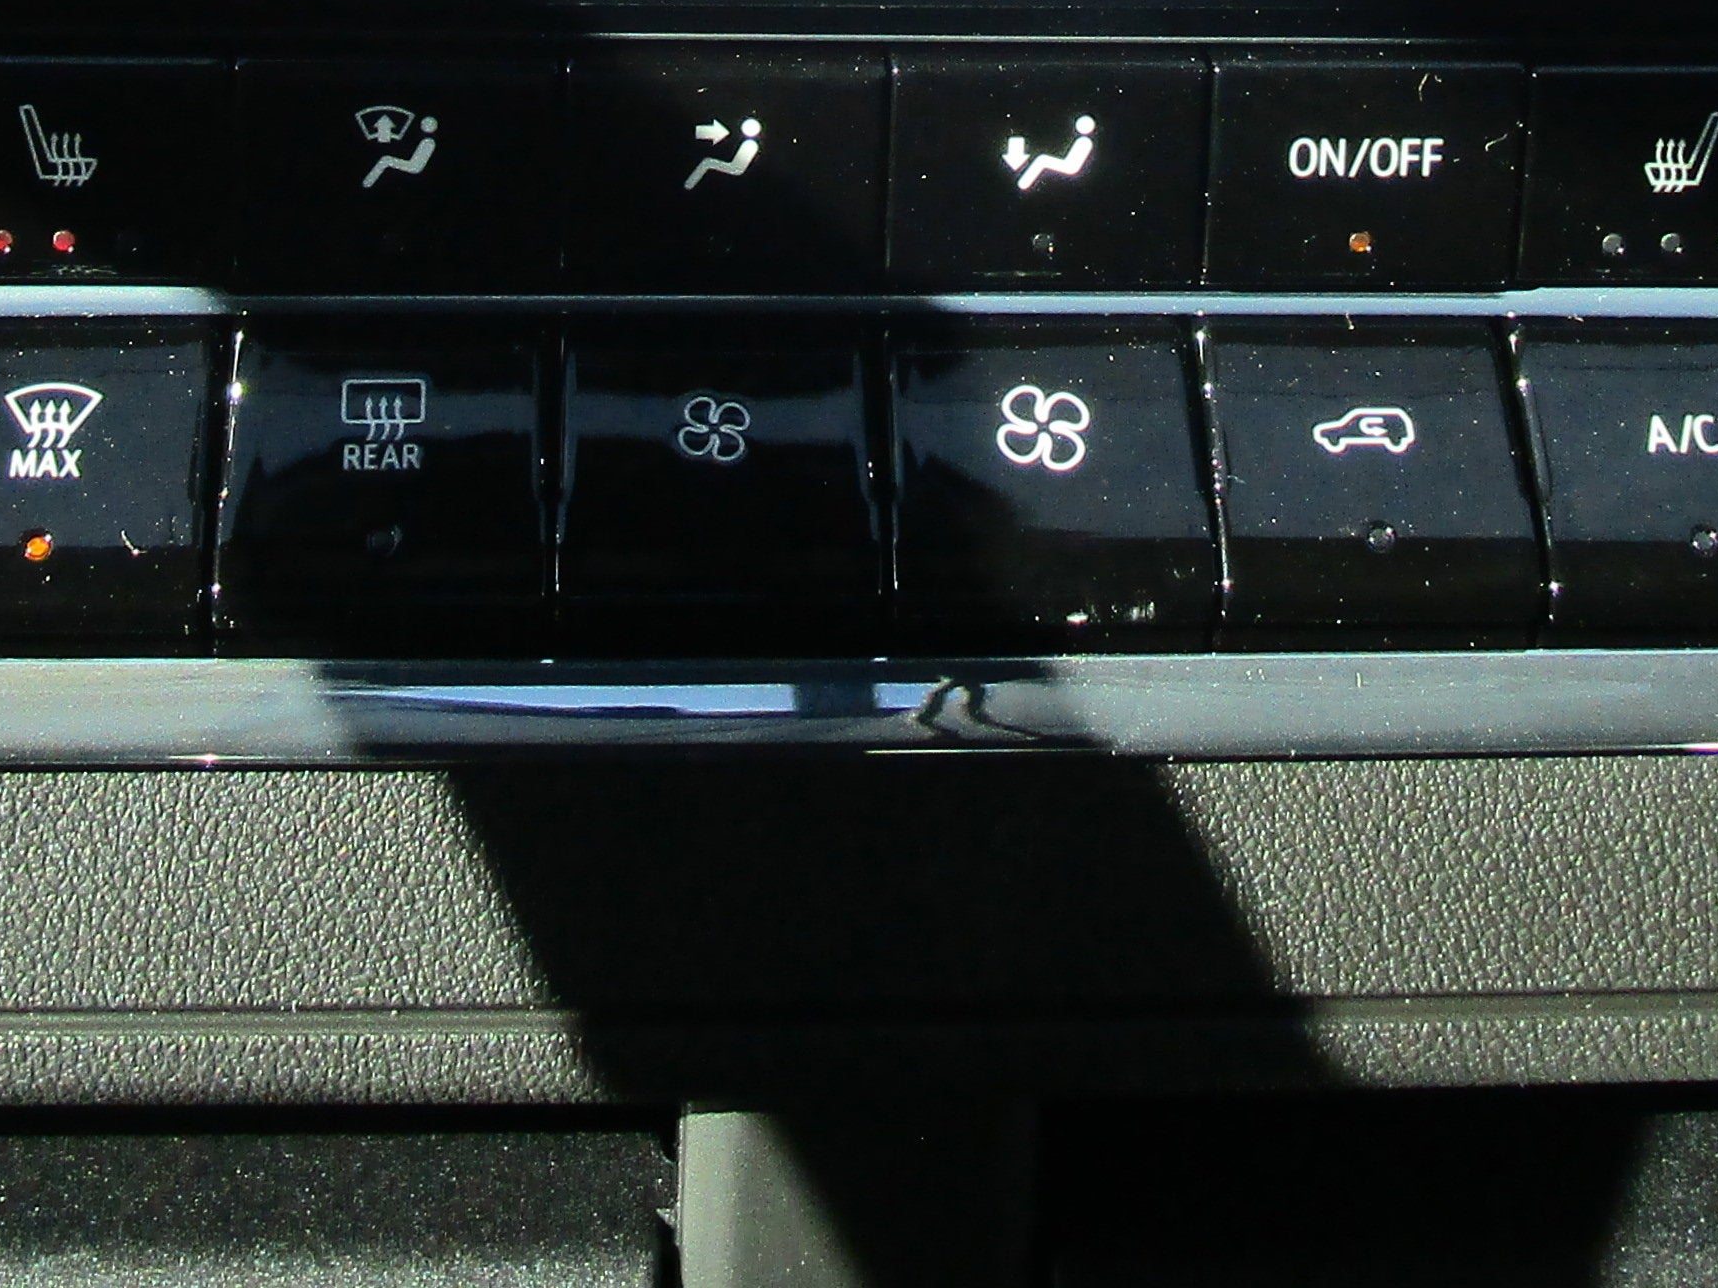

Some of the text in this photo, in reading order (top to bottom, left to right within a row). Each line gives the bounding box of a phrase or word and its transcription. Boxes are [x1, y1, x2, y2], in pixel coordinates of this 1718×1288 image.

[1288, 138, 1444, 180] ON/OFF
[10, 449, 80, 480] MAX
[343, 444, 421, 471] REAR
